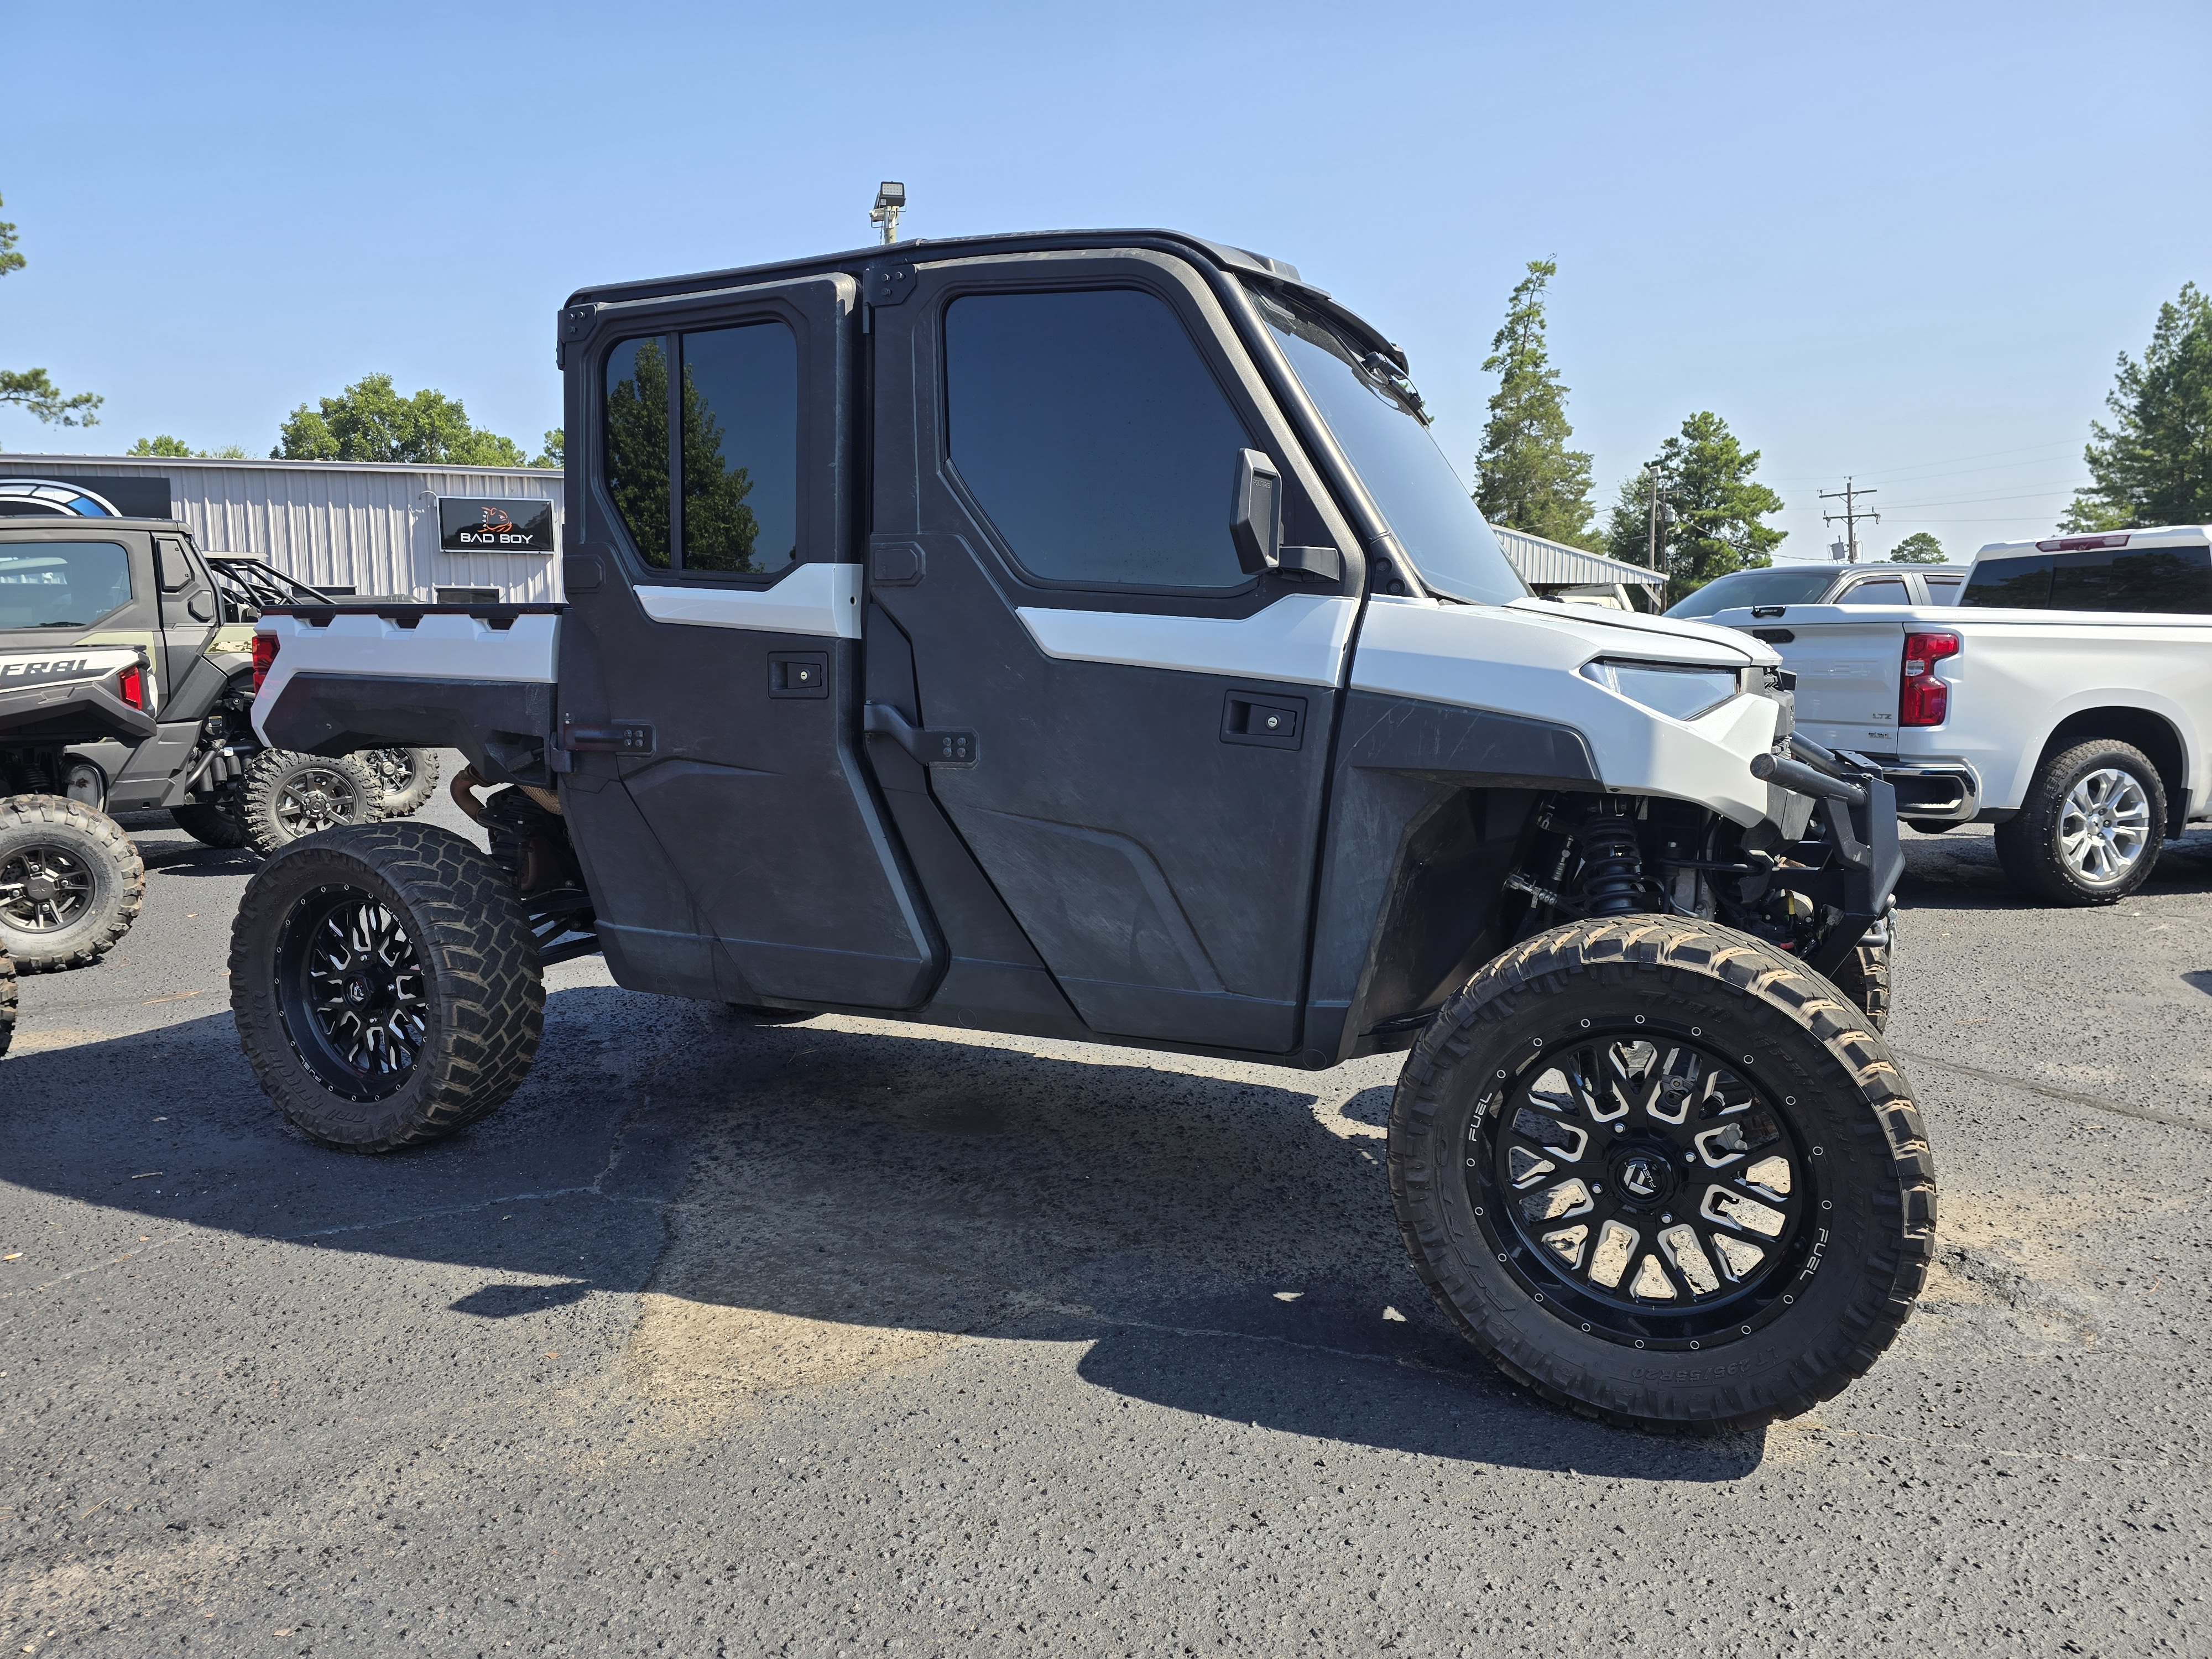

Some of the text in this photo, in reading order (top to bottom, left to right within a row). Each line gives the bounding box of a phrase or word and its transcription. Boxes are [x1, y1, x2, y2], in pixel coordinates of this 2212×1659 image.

[460, 533, 533, 544] BAD BOY
[0, 659, 91, 677] ERAL
[300, 1055, 322, 1083] FUEL
[1468, 1093, 1493, 1142] FUEL
[1642, 1163, 1657, 1188] FUEL
[1799, 1228, 1829, 1280] FUEL
[1631, 1346, 1779, 1383] LT 295/55R20
